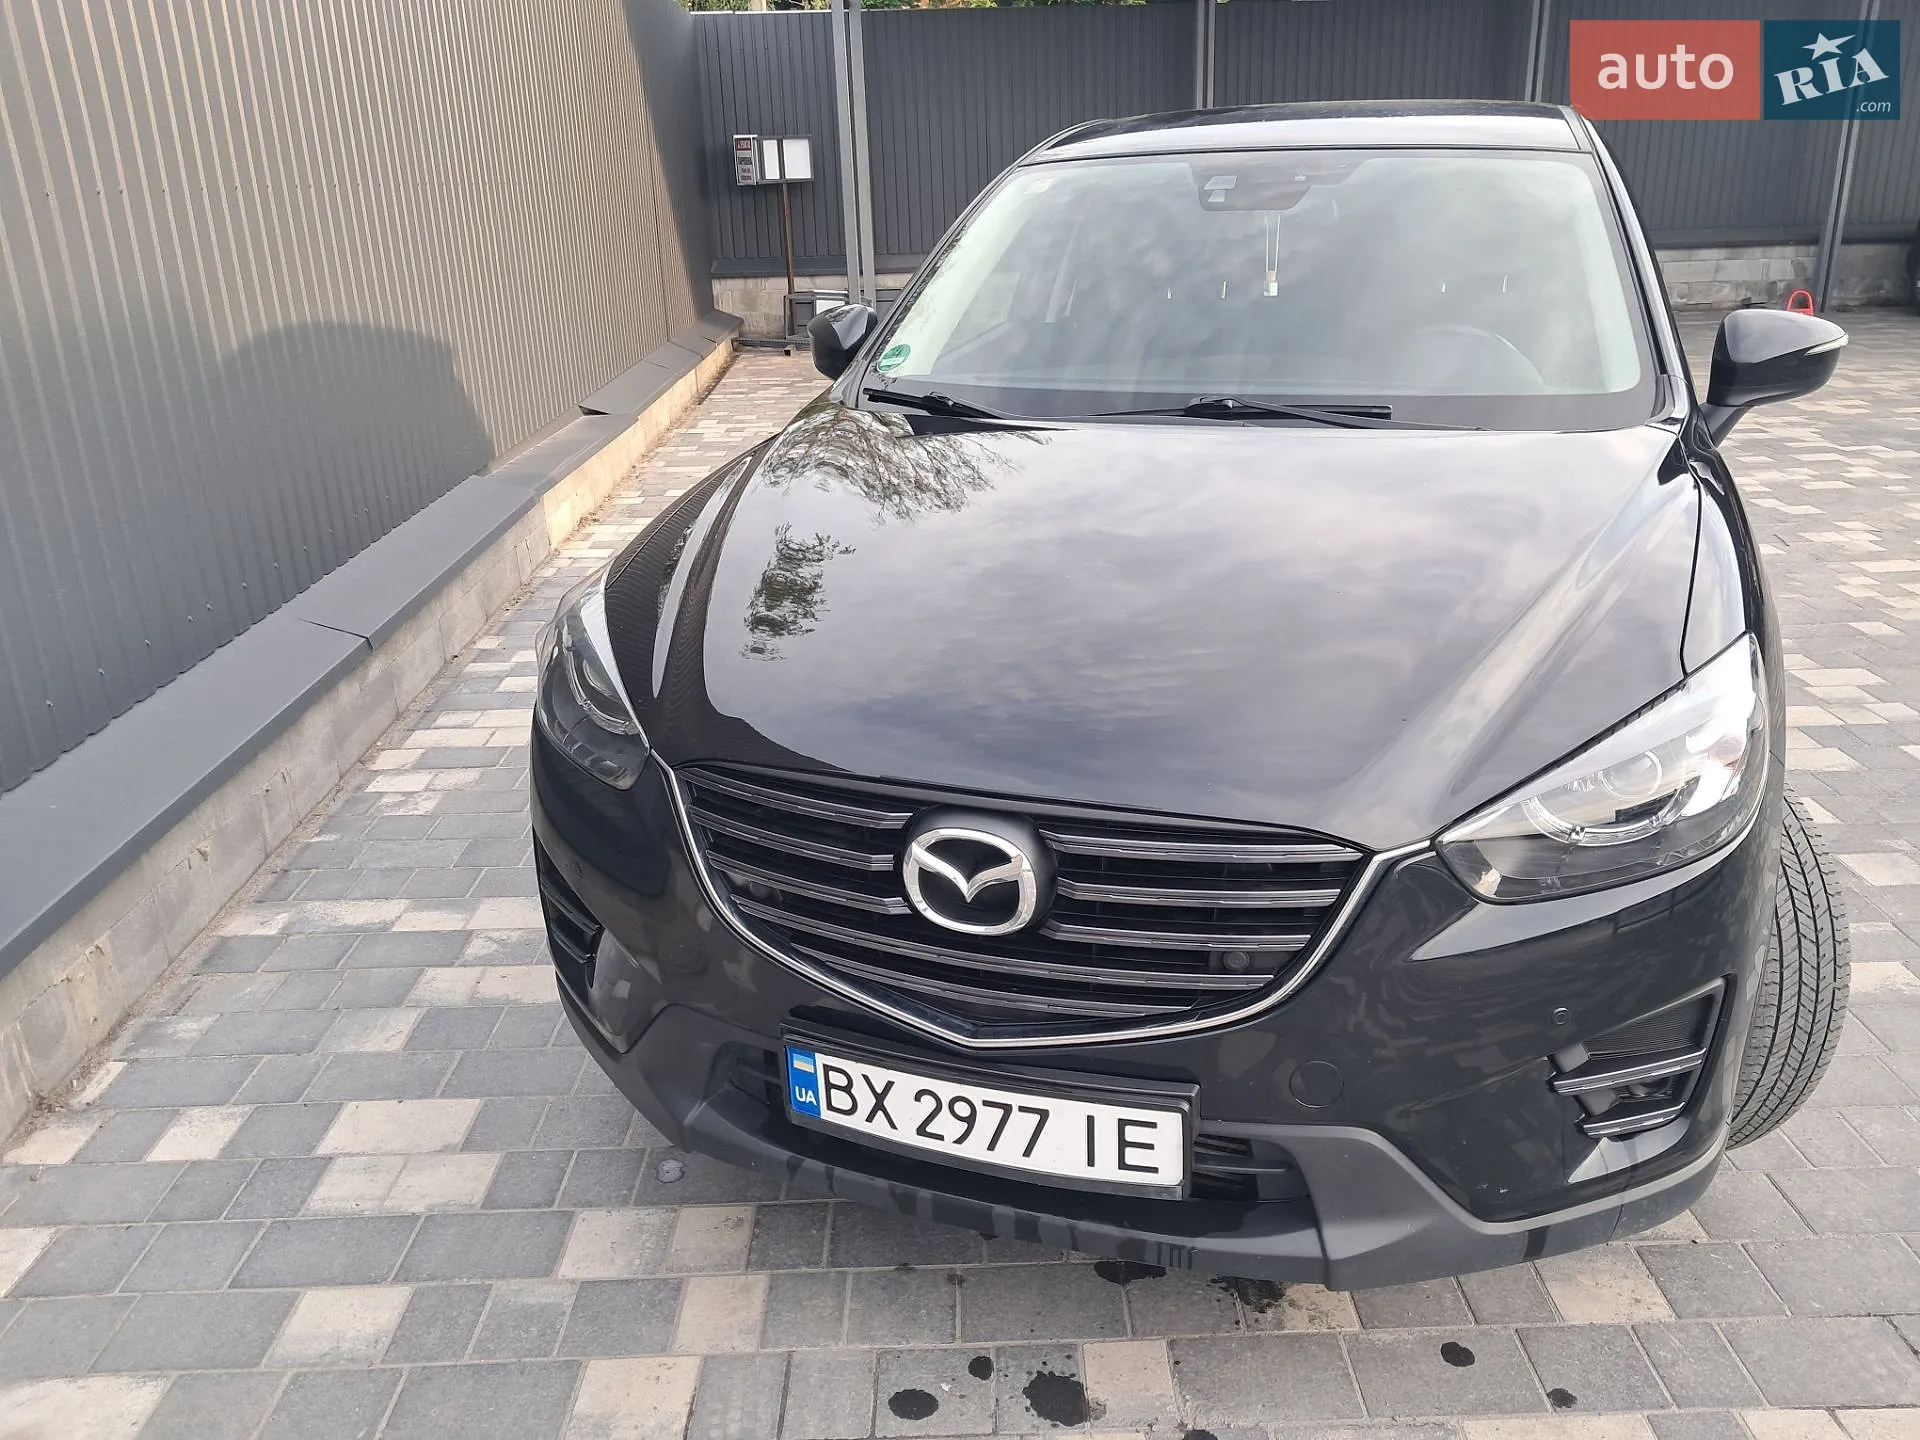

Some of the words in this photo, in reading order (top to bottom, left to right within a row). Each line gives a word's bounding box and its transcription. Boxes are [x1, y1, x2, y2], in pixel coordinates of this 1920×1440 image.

[795, 1086, 817, 1106] UA
[822, 1064, 898, 1130] BX
[913, 1089, 1050, 1158] 2977
[1086, 1115, 1160, 1174] IE
